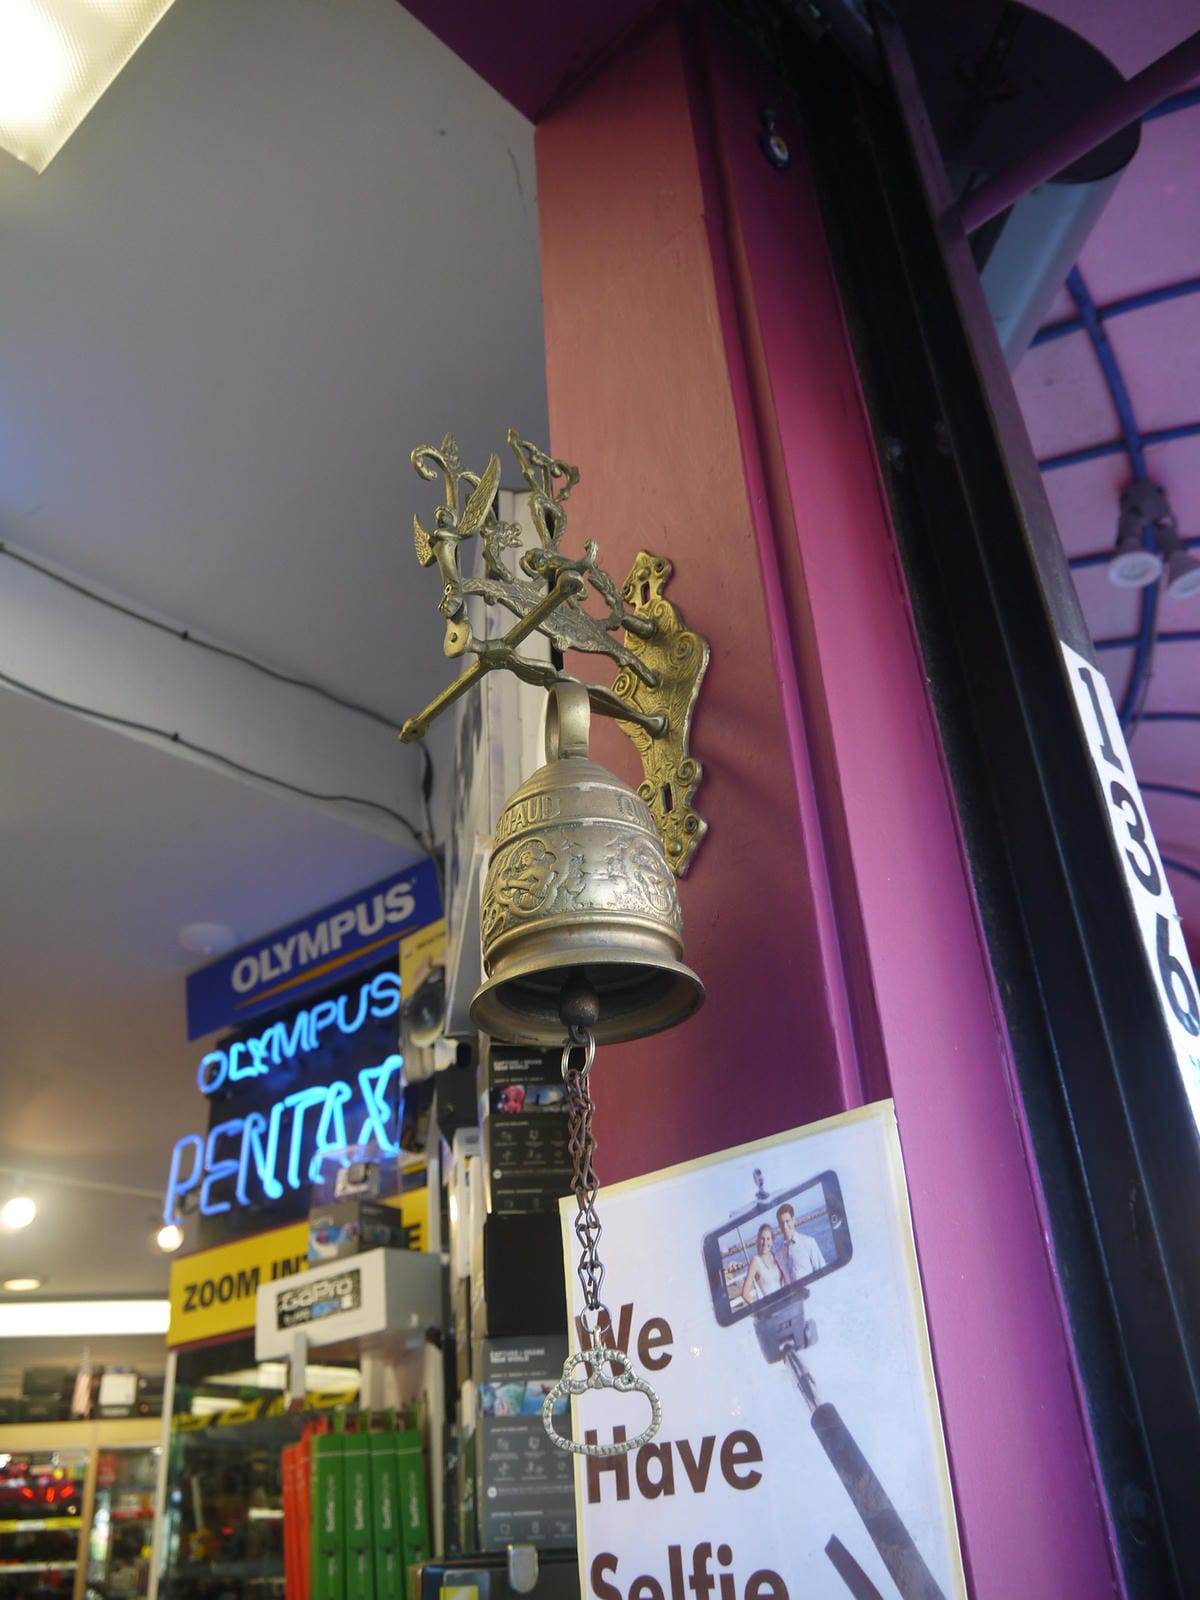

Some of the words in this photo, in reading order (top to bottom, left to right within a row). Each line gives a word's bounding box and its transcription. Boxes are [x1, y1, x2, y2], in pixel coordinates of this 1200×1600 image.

[231, 881, 416, 993] OLYMPUS
[197, 971, 403, 1094] OLYMPUS
[163, 1054, 404, 1225] PENTAX
[183, 1267, 260, 1313] ZOOM
[280, 1276, 353, 1312] GoPro
[575, 1302, 674, 1378] We
[584, 1425, 763, 1504] Have
